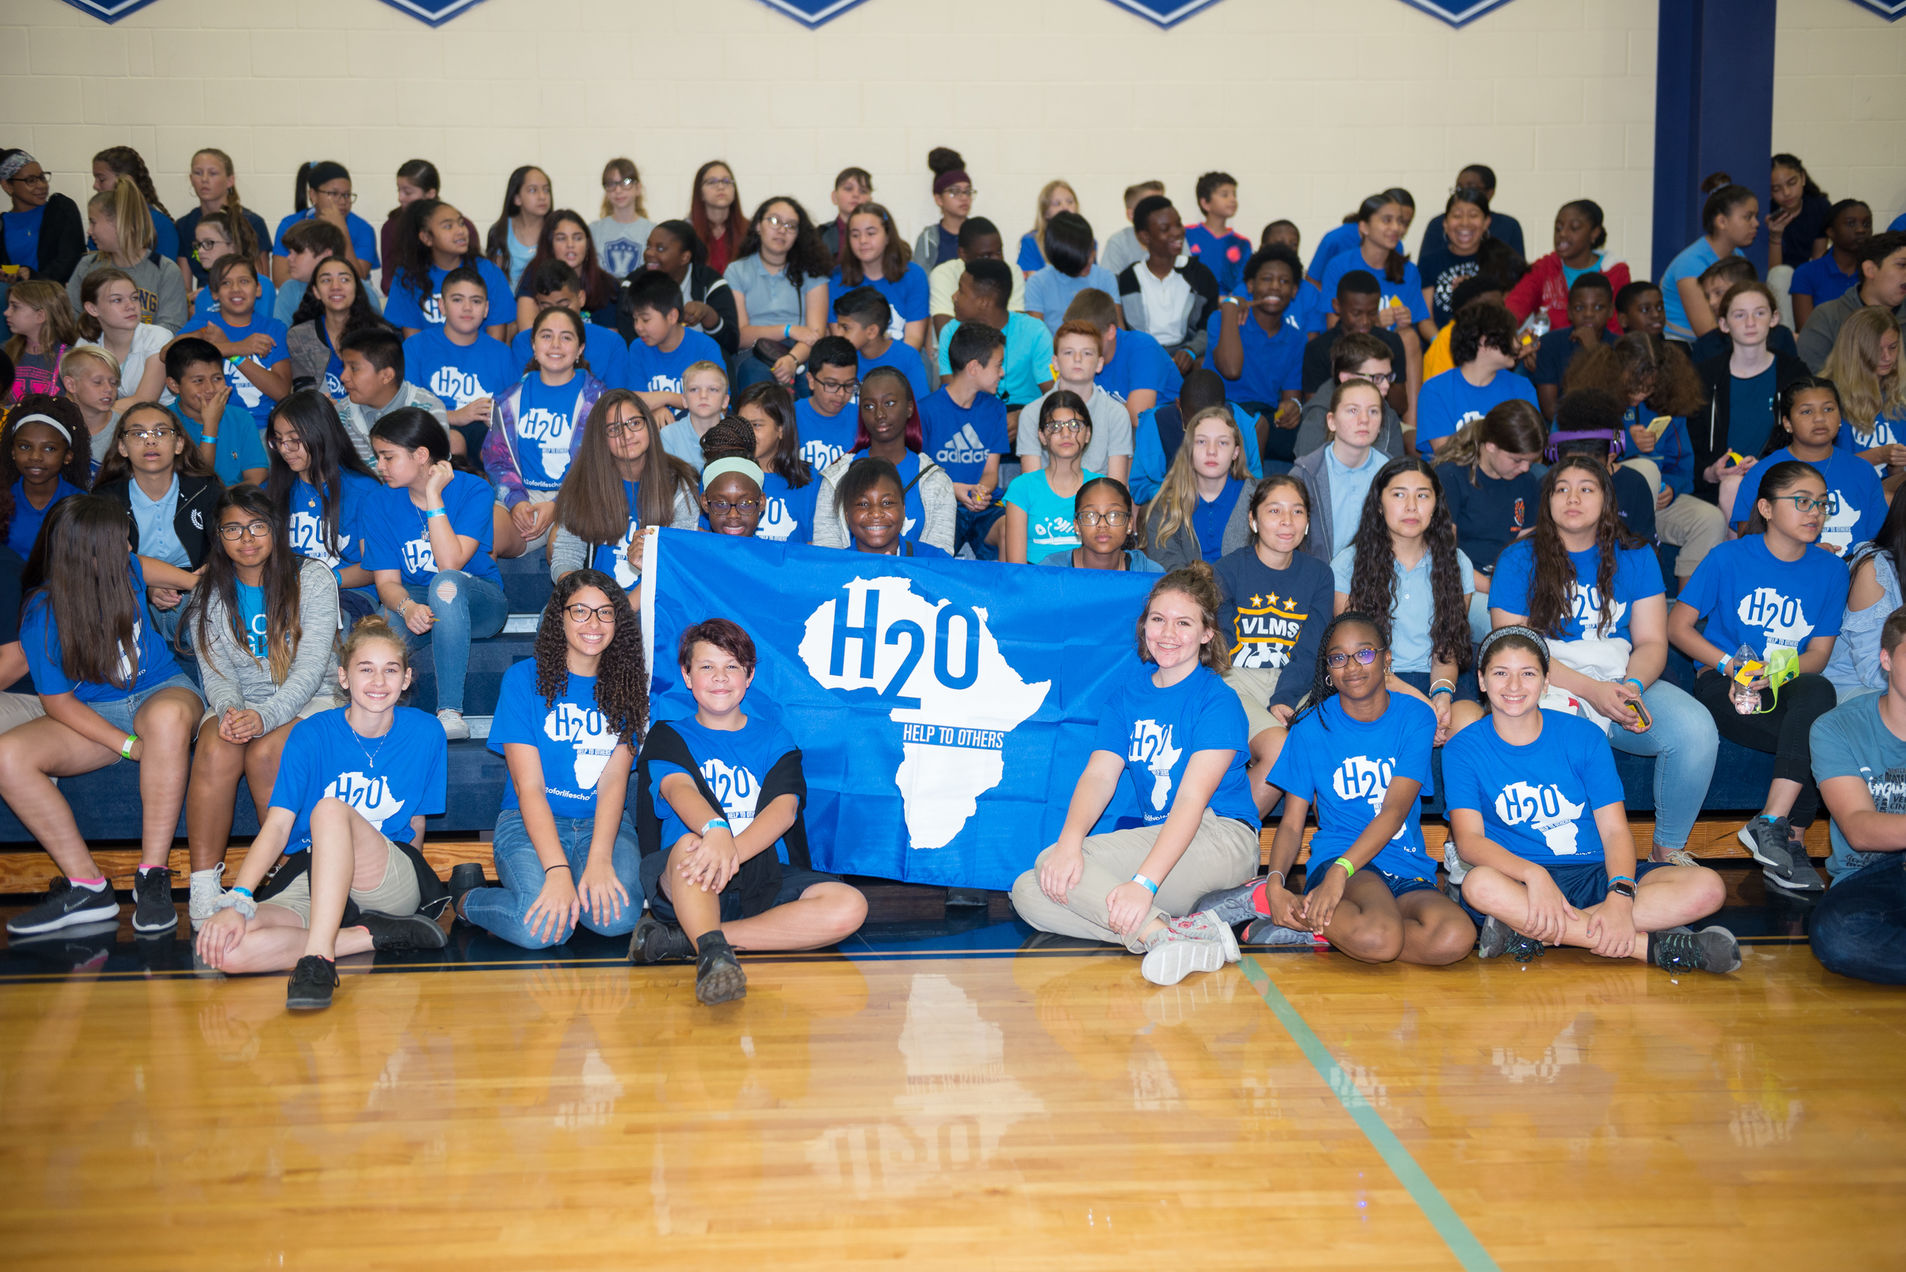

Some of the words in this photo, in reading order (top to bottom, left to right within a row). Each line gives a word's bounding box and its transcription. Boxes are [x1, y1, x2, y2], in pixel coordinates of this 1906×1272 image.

[439, 373, 475, 399] H2O
[524, 412, 563, 444] H2O
[936, 448, 991, 464] adidas
[1241, 616, 1300, 639] VLMS
[1748, 592, 1798, 633] H2O
[829, 589, 981, 710] H2O
[556, 706, 602, 744] H2O
[903, 723, 935, 743] HELP
[939, 726, 954, 744] TO
[957, 727, 1004, 749] OTHERS
[1341, 759, 1394, 799] H2O
[1503, 785, 1560, 825] H2O
